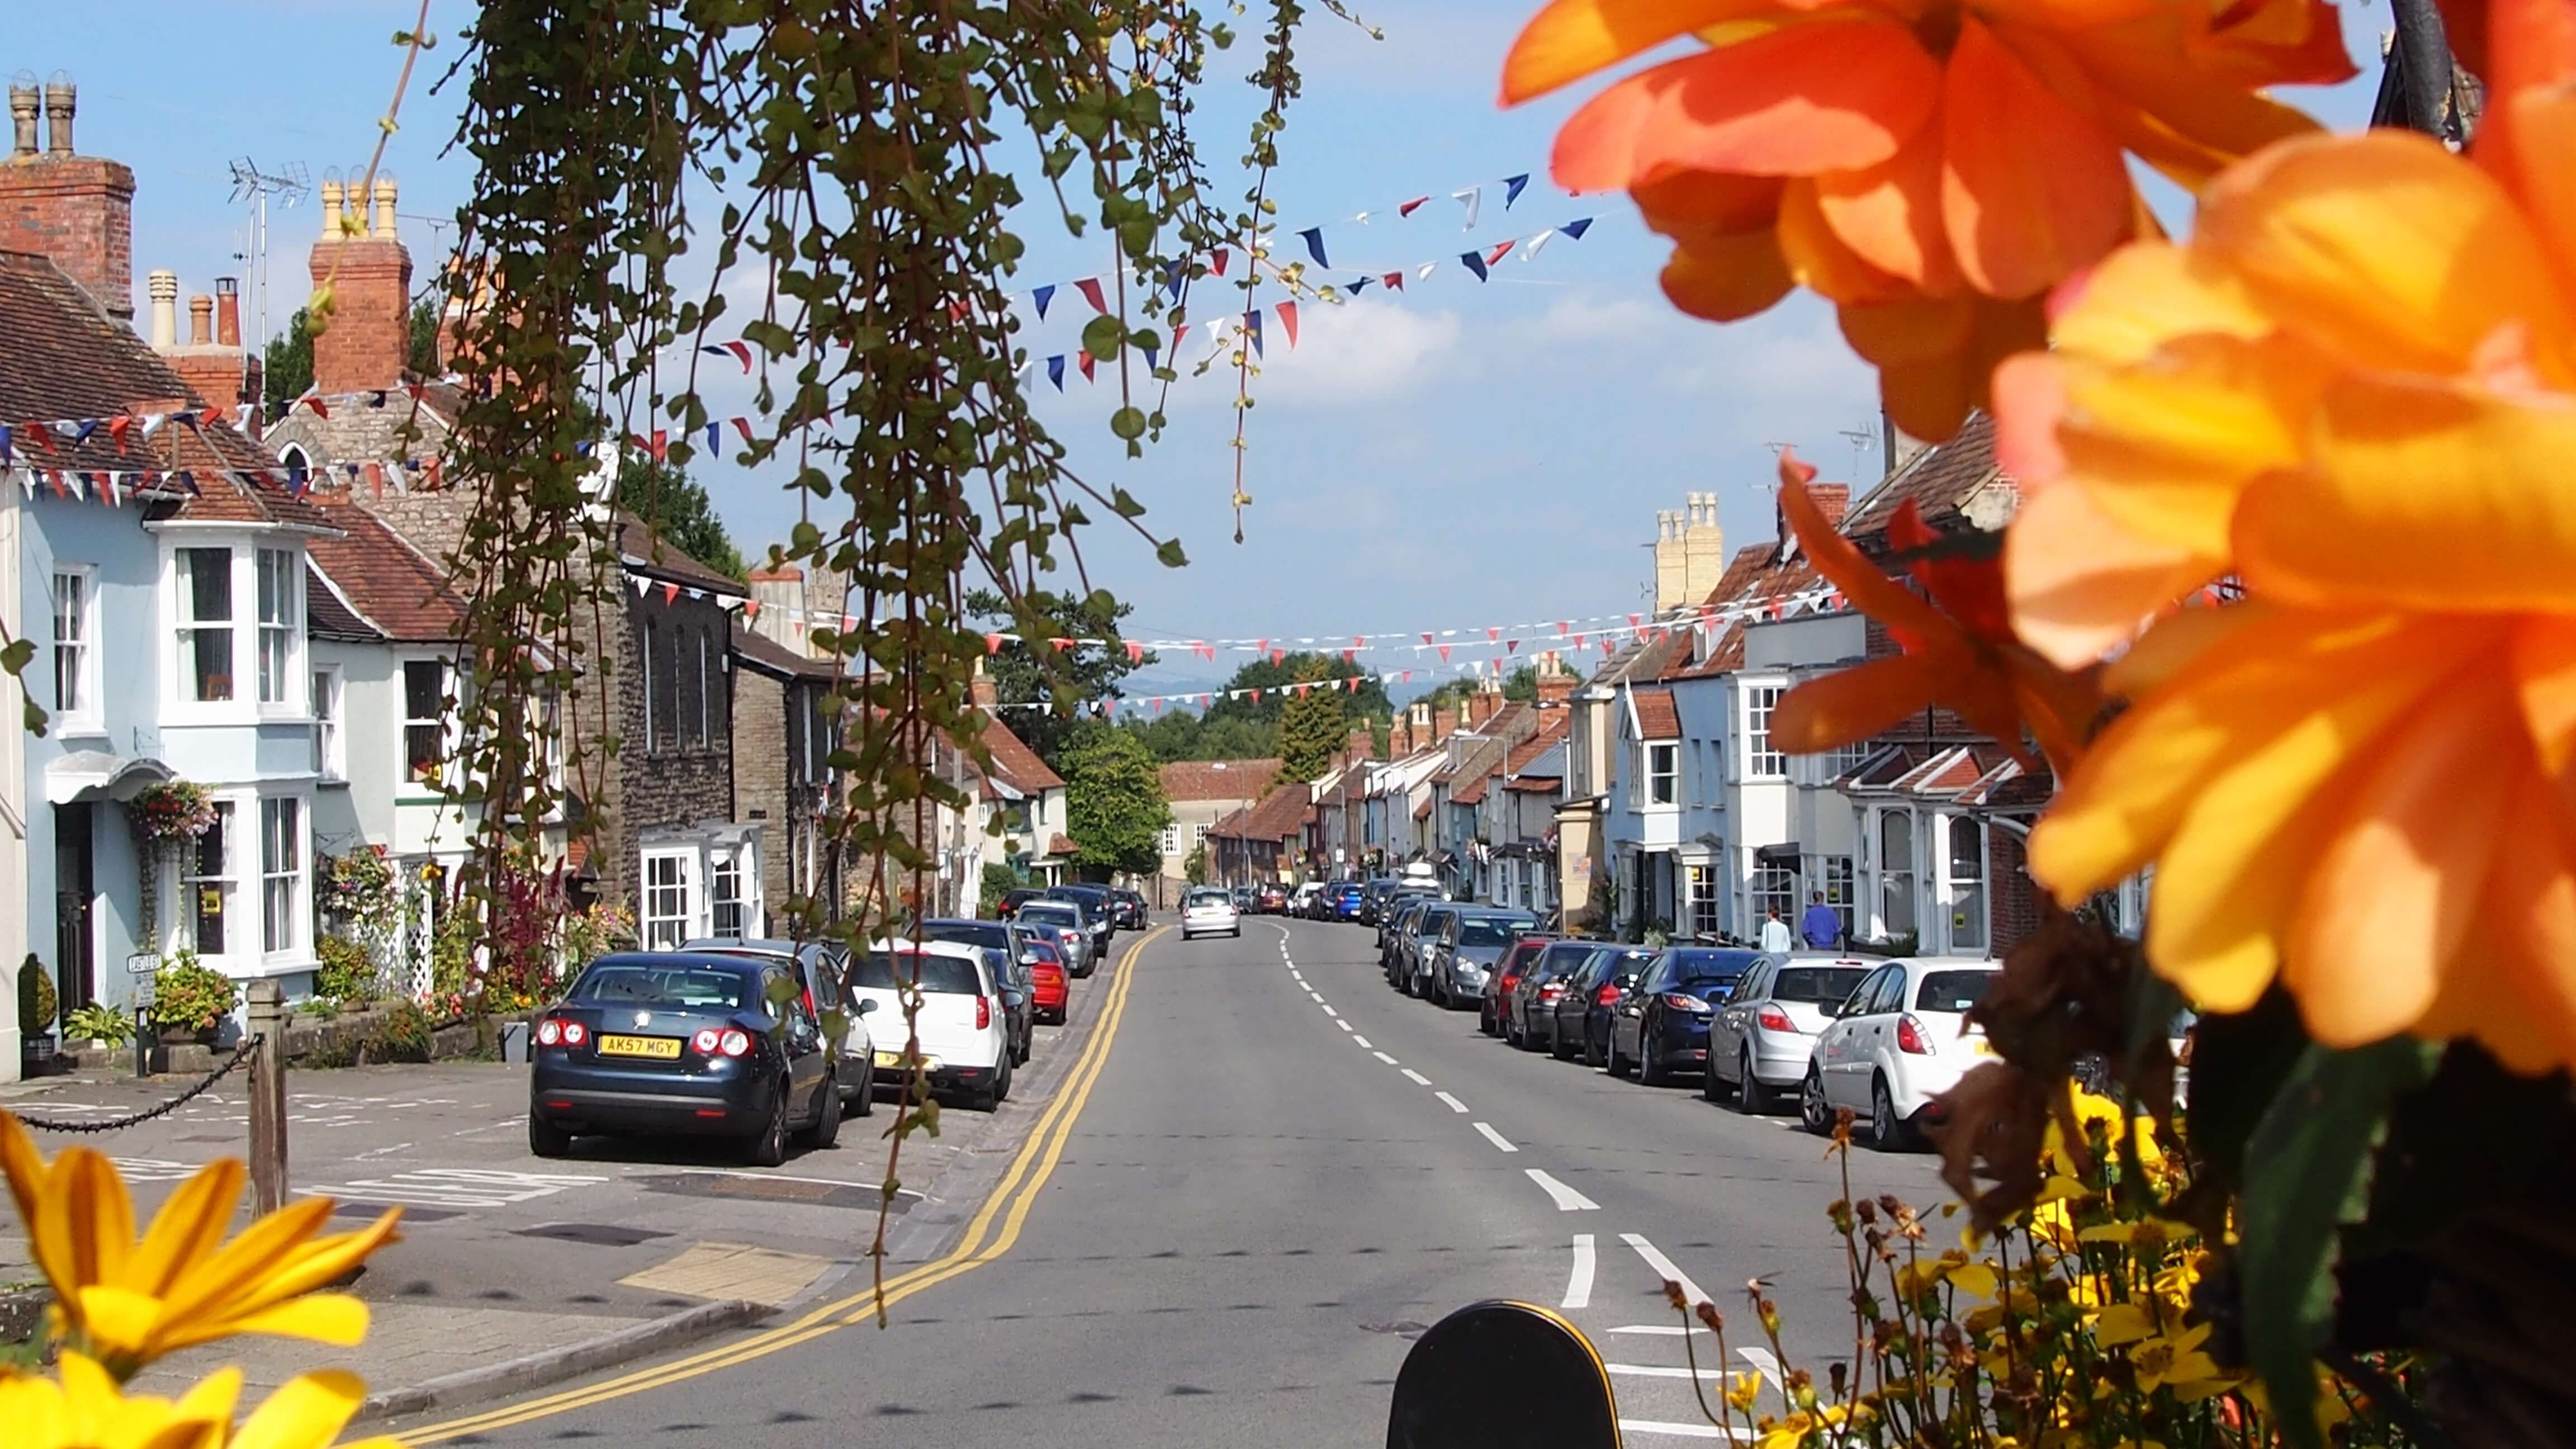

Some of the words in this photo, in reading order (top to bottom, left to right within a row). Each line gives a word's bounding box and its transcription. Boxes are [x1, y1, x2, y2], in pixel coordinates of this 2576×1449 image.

[608, 1038, 643, 1052] AK57
[646, 1041, 673, 1054] MGY
[291, 1169, 609, 1206] CLEAR
